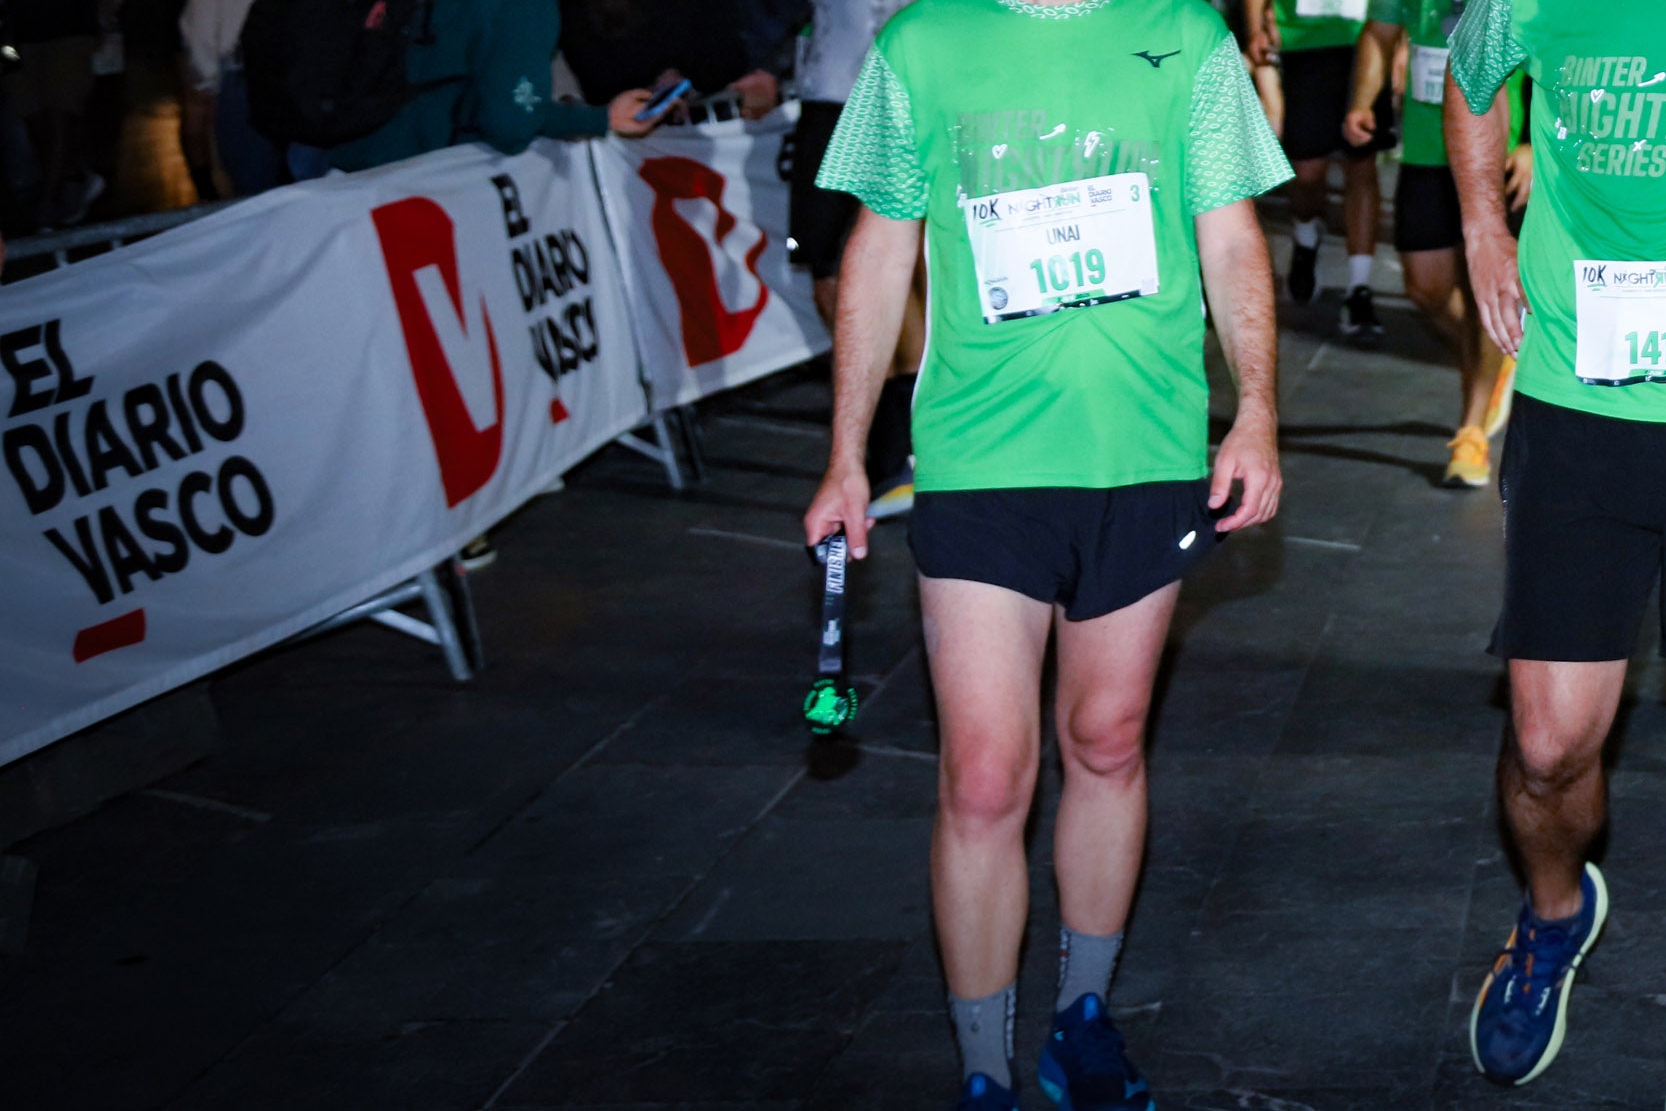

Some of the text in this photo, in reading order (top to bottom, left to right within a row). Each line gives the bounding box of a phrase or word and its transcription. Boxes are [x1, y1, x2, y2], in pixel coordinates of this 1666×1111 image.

[972, 197, 1001, 220] 10K
[1129, 185, 1140, 202] 3
[1030, 249, 1106, 294] 1019
[1582, 265, 1607, 286] 10K
[1, 319, 95, 418] EL
[4, 360, 244, 515] DIARIO
[43, 455, 274, 604] VASCO
